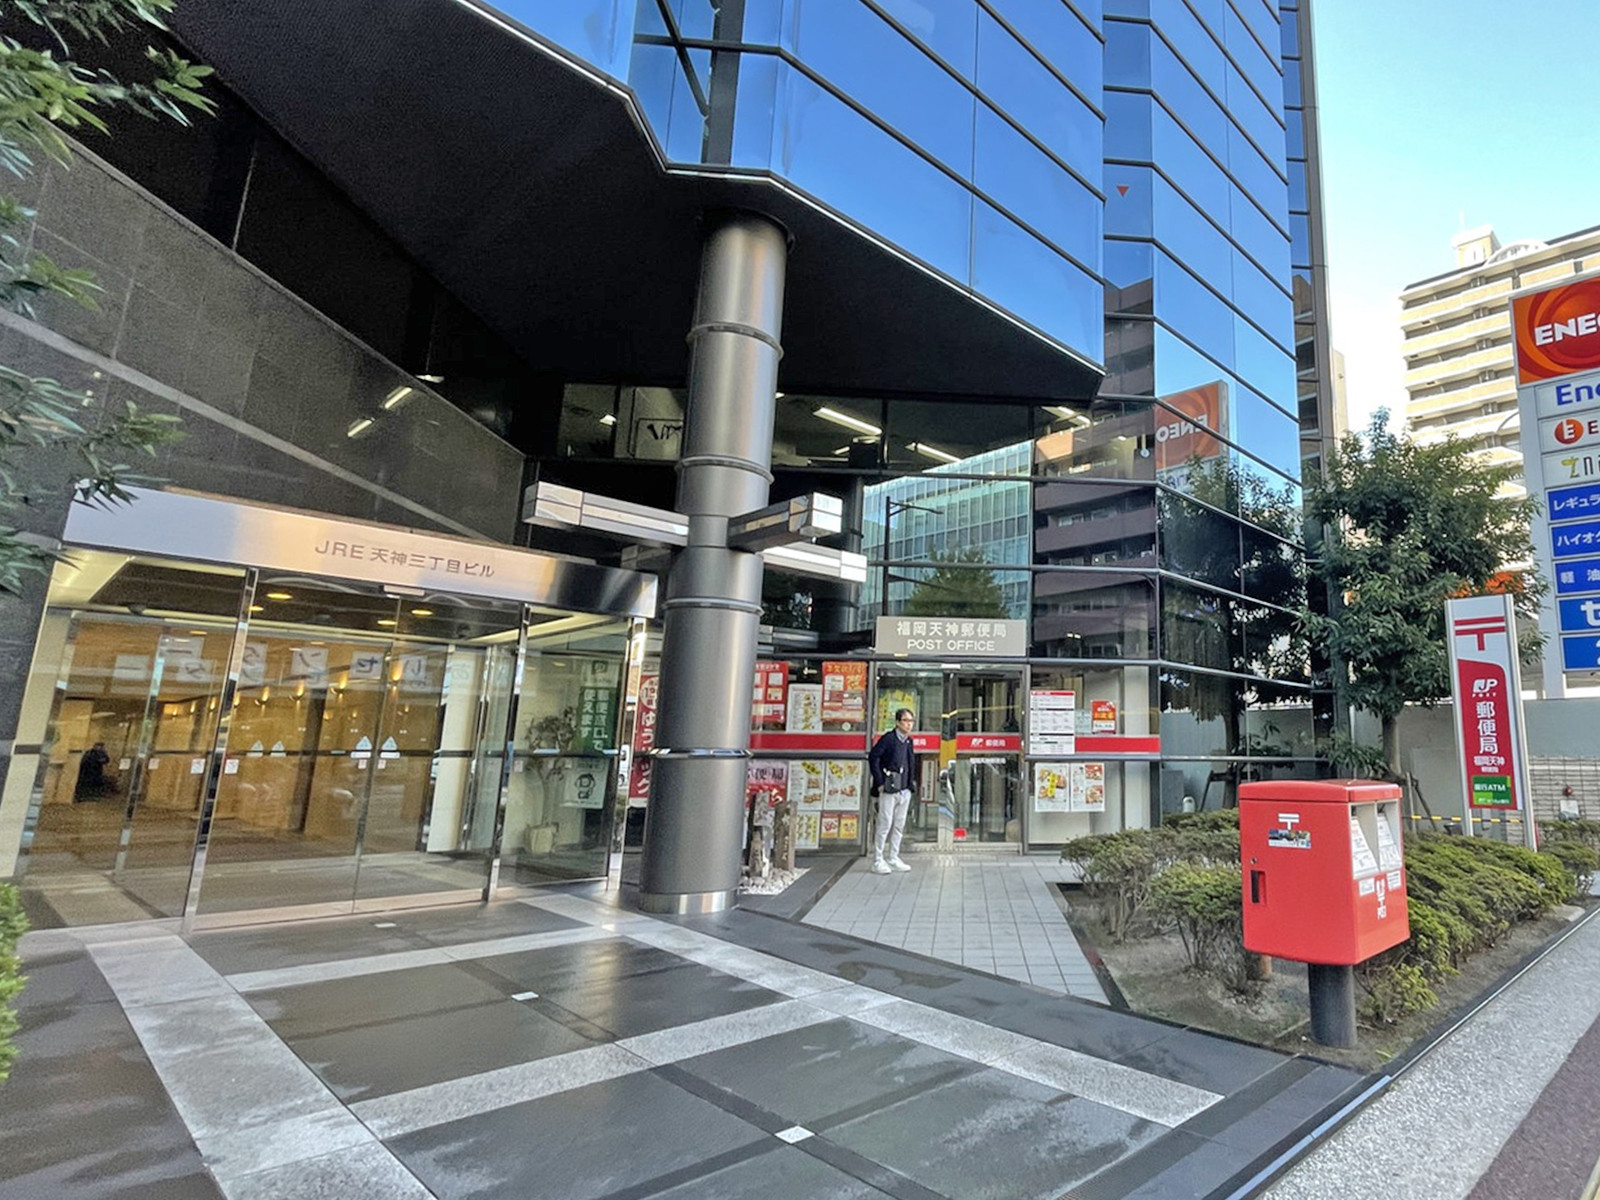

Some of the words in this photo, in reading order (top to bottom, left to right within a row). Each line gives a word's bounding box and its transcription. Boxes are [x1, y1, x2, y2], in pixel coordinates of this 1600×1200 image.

[1535, 312, 1600, 346] ENE
[315, 540, 364, 560] JRE
[370, 547, 495, 578] 天神三丁目ビル
[896, 620, 1007, 638] 福岡天神郵便局
[907, 639, 943, 650] POST
[947, 640, 995, 652] OFFICE
[1476, 701, 1499, 754] 郵便局
